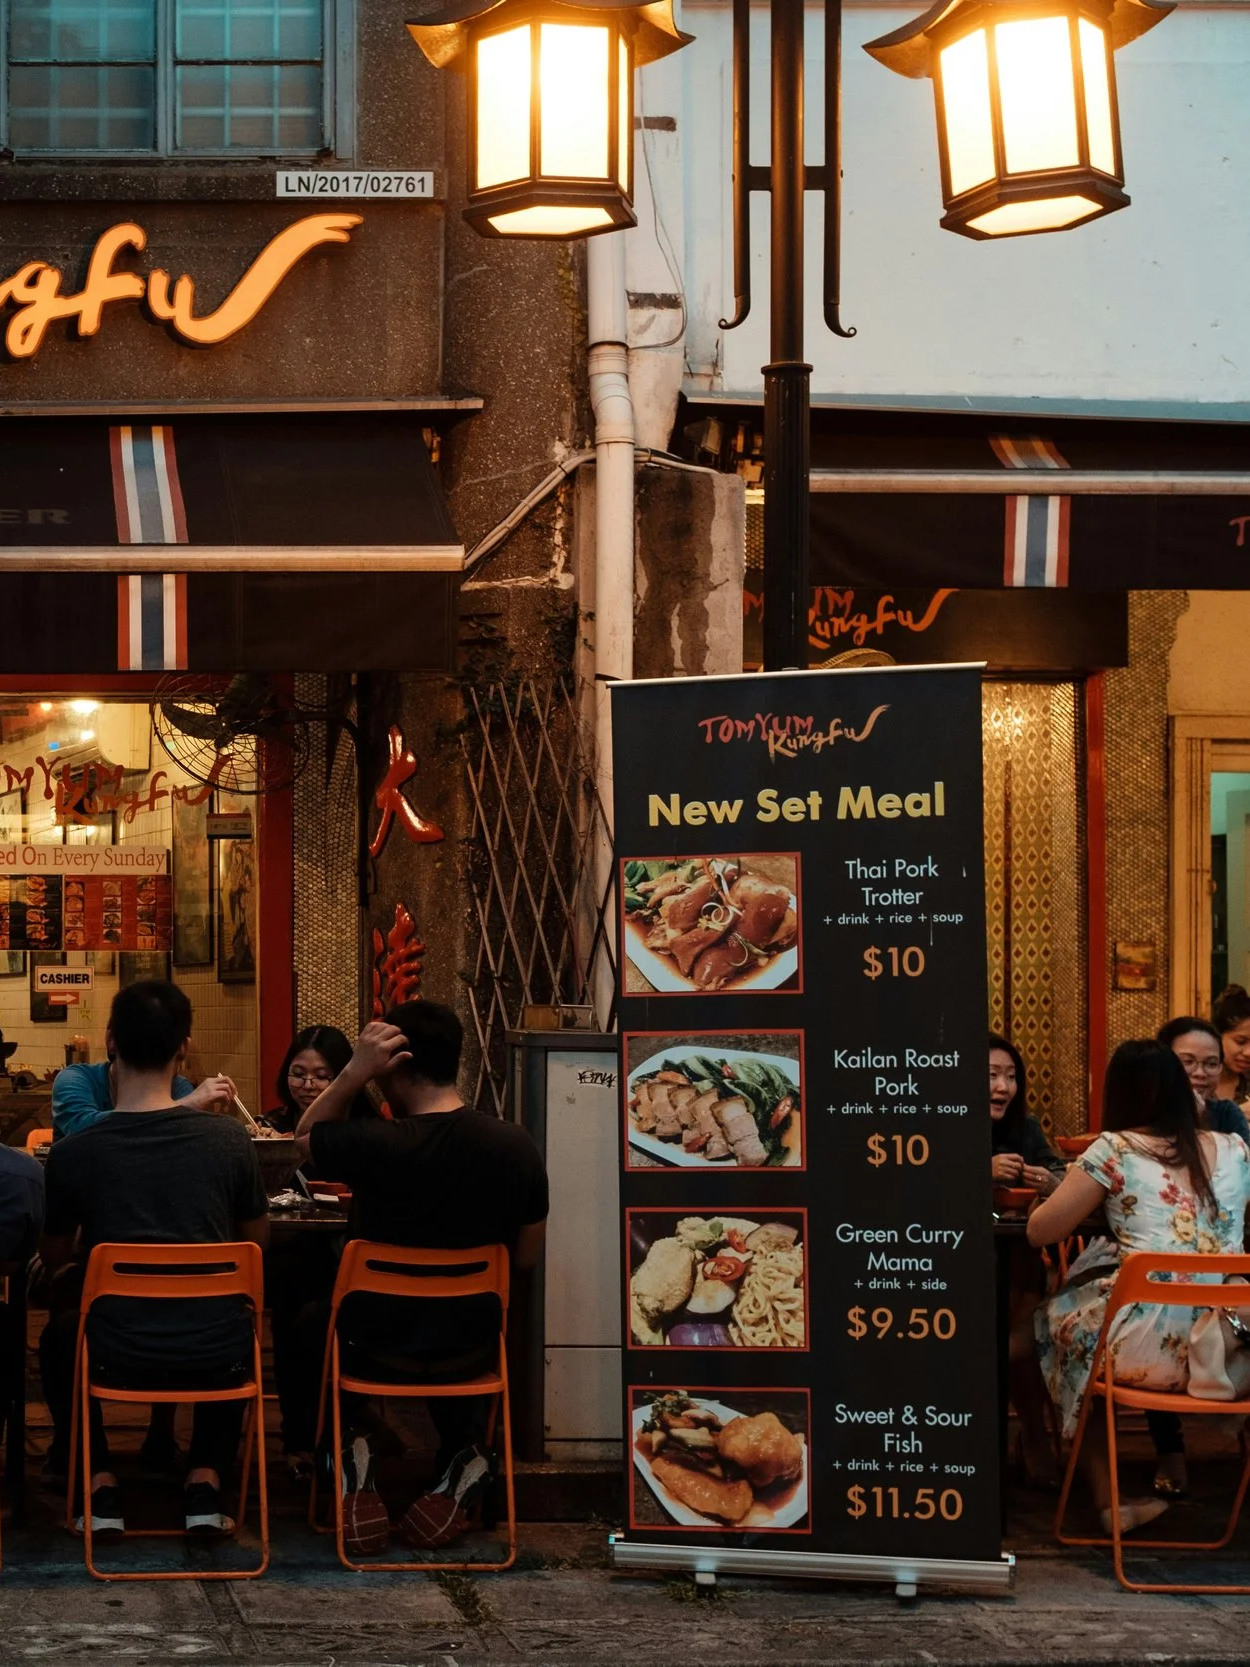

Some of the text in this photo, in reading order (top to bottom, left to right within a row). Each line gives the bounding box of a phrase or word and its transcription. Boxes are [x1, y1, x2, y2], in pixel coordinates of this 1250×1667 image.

[284, 175, 426, 194] LN/2017/02761
[648, 781, 945, 827] New Set Meal
[22, 846, 48, 867] On
[53, 848, 100, 873] Every
[104, 845, 166, 873] Sunday
[845, 855, 939, 880] Thai Pork
[861, 887, 924, 906] Trotter
[837, 912, 870, 925] drink
[889, 912, 913, 924] rice
[932, 913, 964, 924] soup
[863, 945, 925, 980] $10
[39, 973, 91, 986] CASHIER
[834, 1046, 960, 1069] Kailan Roast
[875, 1074, 919, 1096] Pork
[841, 1102, 874, 1114] drink
[893, 1102, 917, 1114] rice
[937, 1104, 968, 1116] soup
[866, 1132, 930, 1168] $10
[835, 1223, 964, 1250] Green Curry
[867, 1252, 933, 1272] Mama
[868, 1277, 901, 1290] drink
[921, 1278, 948, 1290] side
[847, 1305, 957, 1341] $9.50
[834, 1404, 973, 1427] Sweet & Sour
[884, 1431, 923, 1454] Fish
[847, 1458, 880, 1471] drink
[900, 1460, 924, 1473] rice
[944, 1463, 976, 1477] soup
[846, 1483, 963, 1521] $11.50
